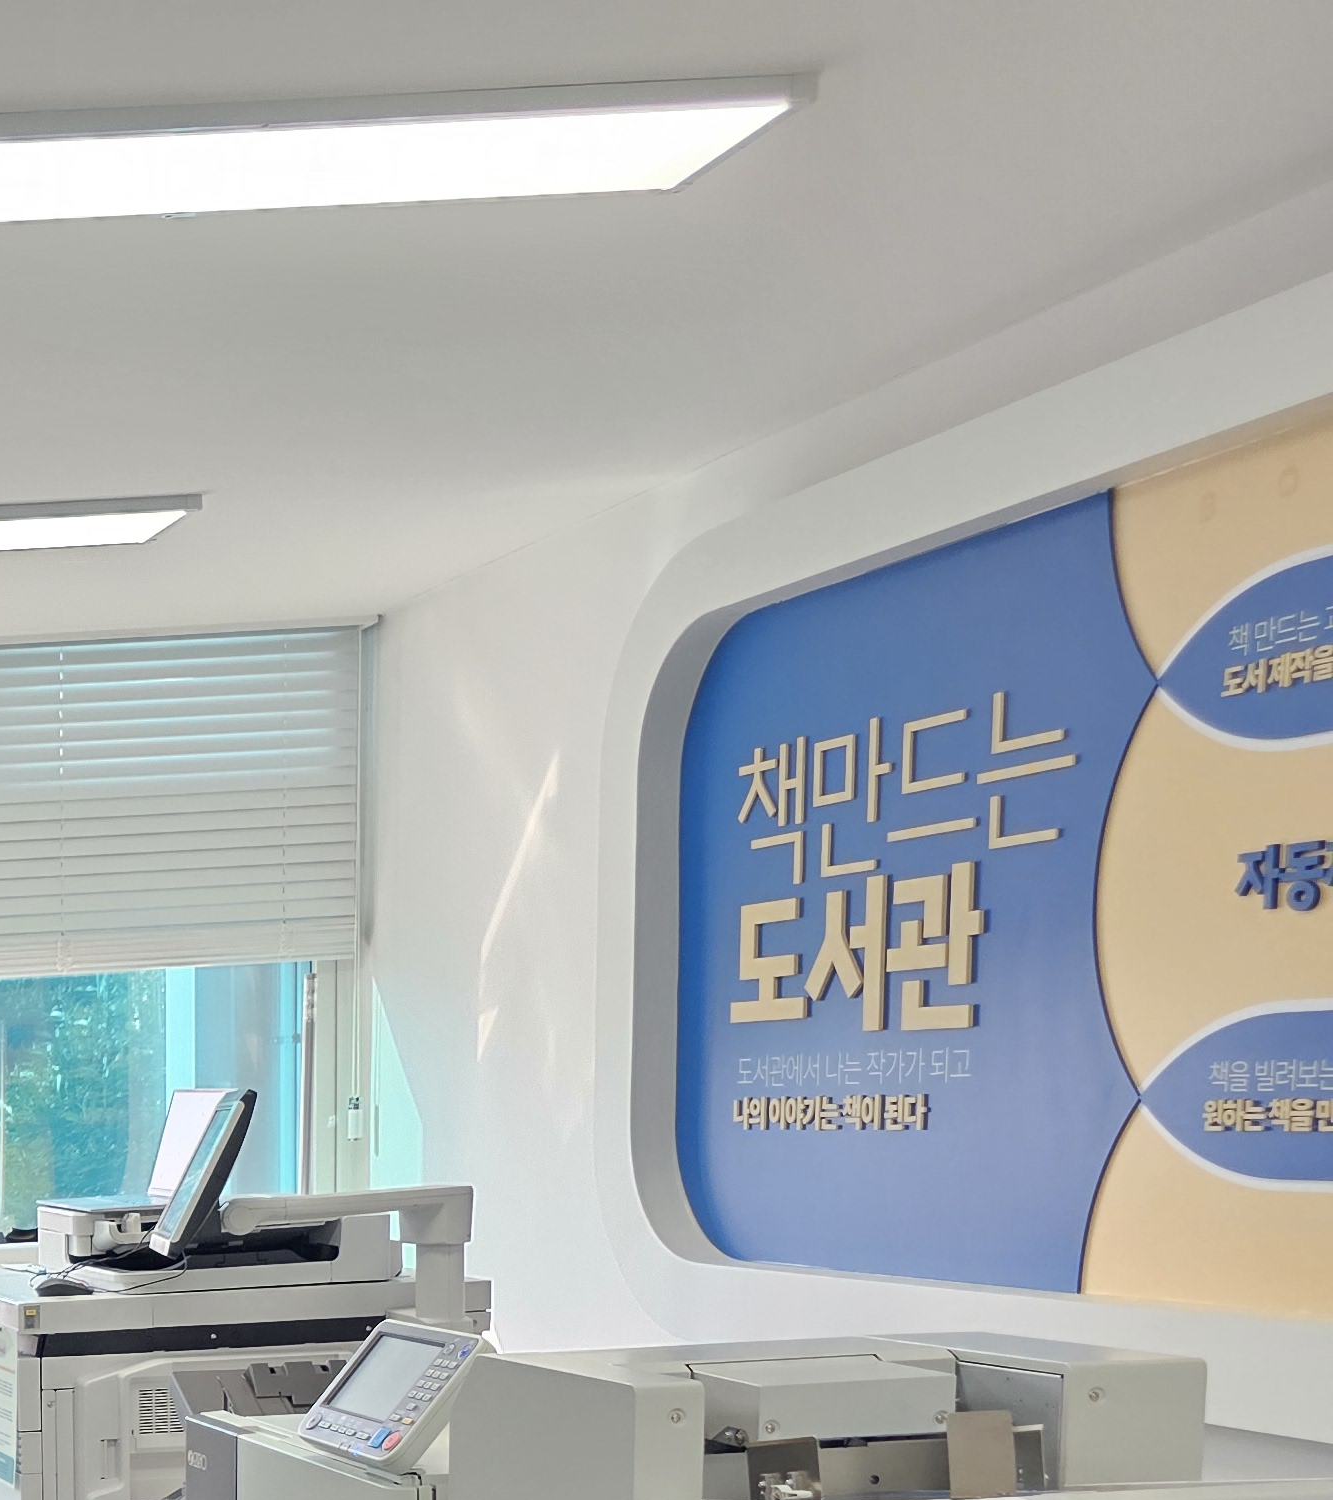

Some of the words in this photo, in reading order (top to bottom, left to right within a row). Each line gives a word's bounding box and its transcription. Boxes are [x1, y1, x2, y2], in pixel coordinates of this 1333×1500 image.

[1228, 622, 1251, 656] 책
[1254, 611, 1321, 652] 만드는
[1220, 658, 1268, 698] 도서
[1234, 839, 1333, 912] 자동
[729, 861, 987, 1032] 도서관
[736, 1053, 821, 1088] 도서관에서
[825, 1050, 863, 1086] 나는
[866, 1047, 926, 1086] 작가가
[929, 1046, 973, 1084] 되고
[1208, 1060, 1250, 1092] 책을
[732, 1096, 768, 1132] 나의
[768, 1095, 846, 1132] 이야기는
[842, 1093, 884, 1132] 책이
[884, 1093, 930, 1132] 된다
[1202, 1098, 1268, 1132] 원하는
[1268, 1098, 1314, 1132] 책을
